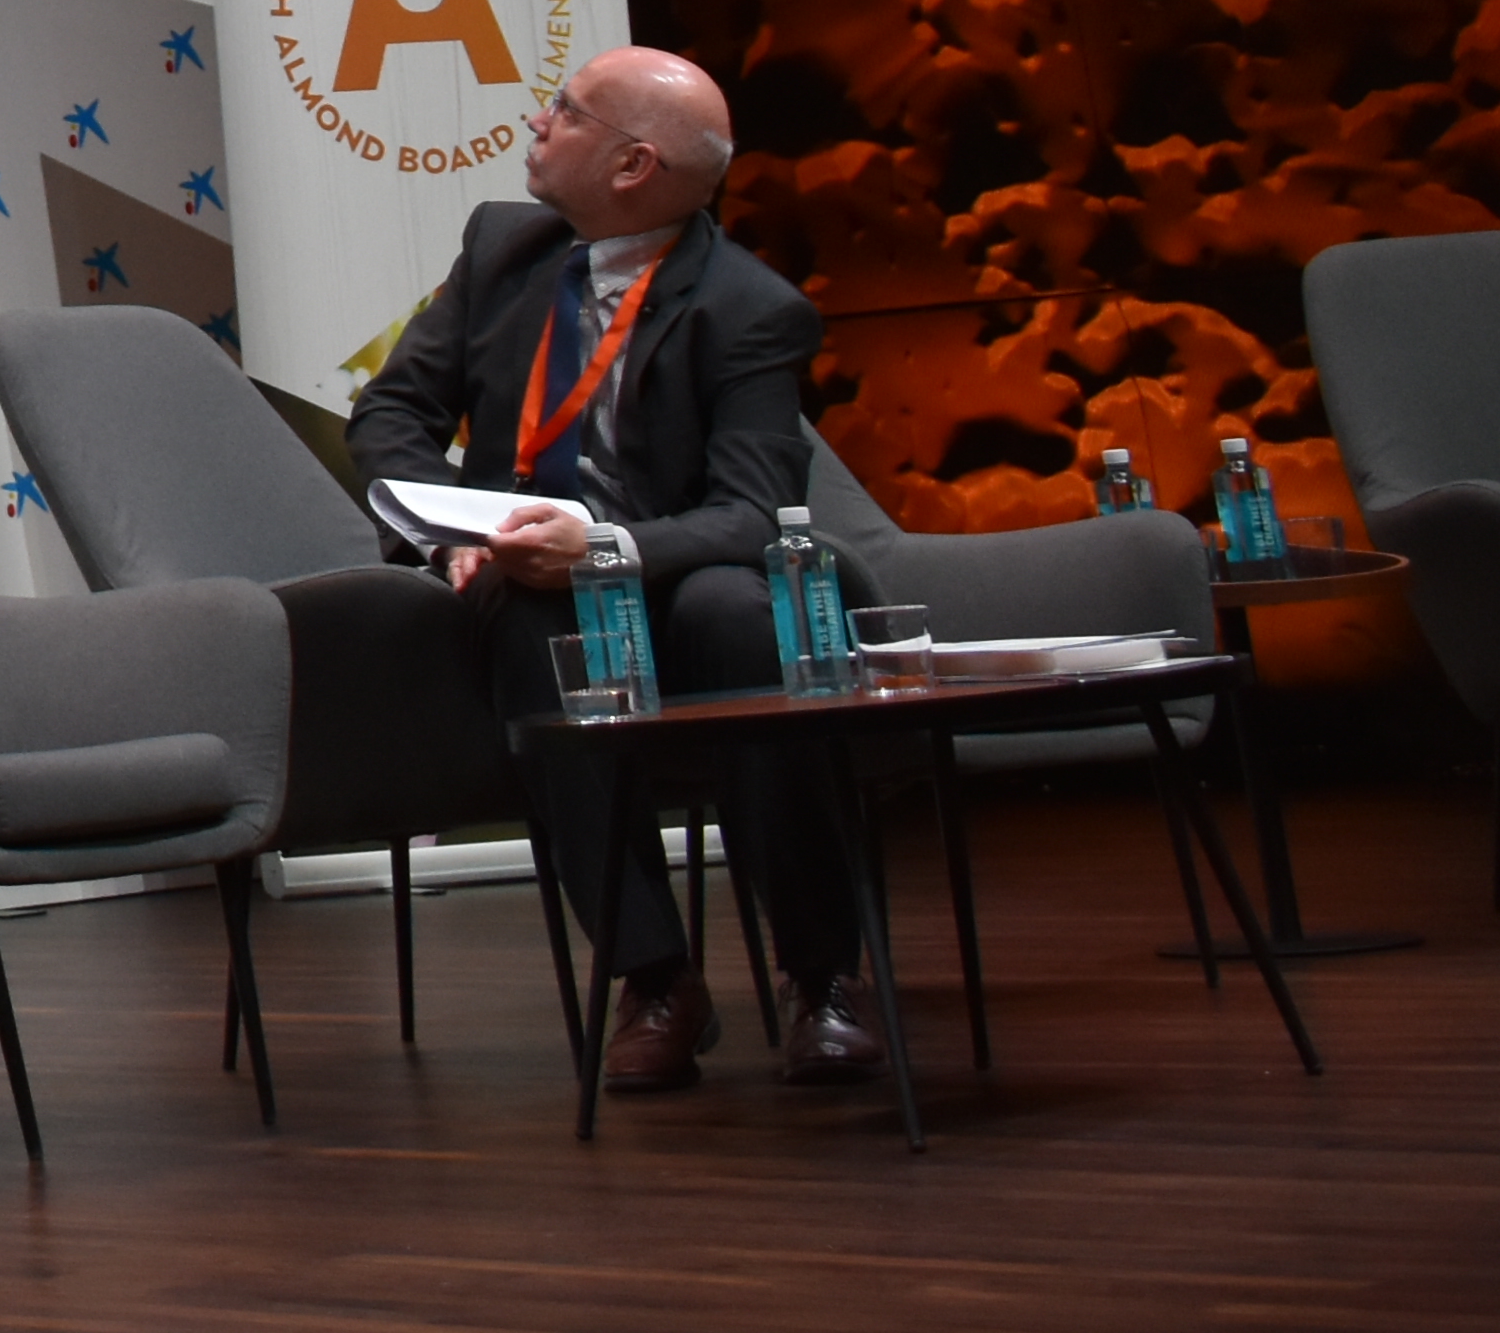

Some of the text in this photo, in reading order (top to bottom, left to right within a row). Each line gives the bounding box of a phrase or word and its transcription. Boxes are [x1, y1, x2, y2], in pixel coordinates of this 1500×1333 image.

[273, 34, 385, 162] ALMOND
[398, 124, 515, 174] BOARD
[628, 607, 646, 661] CHANGE
